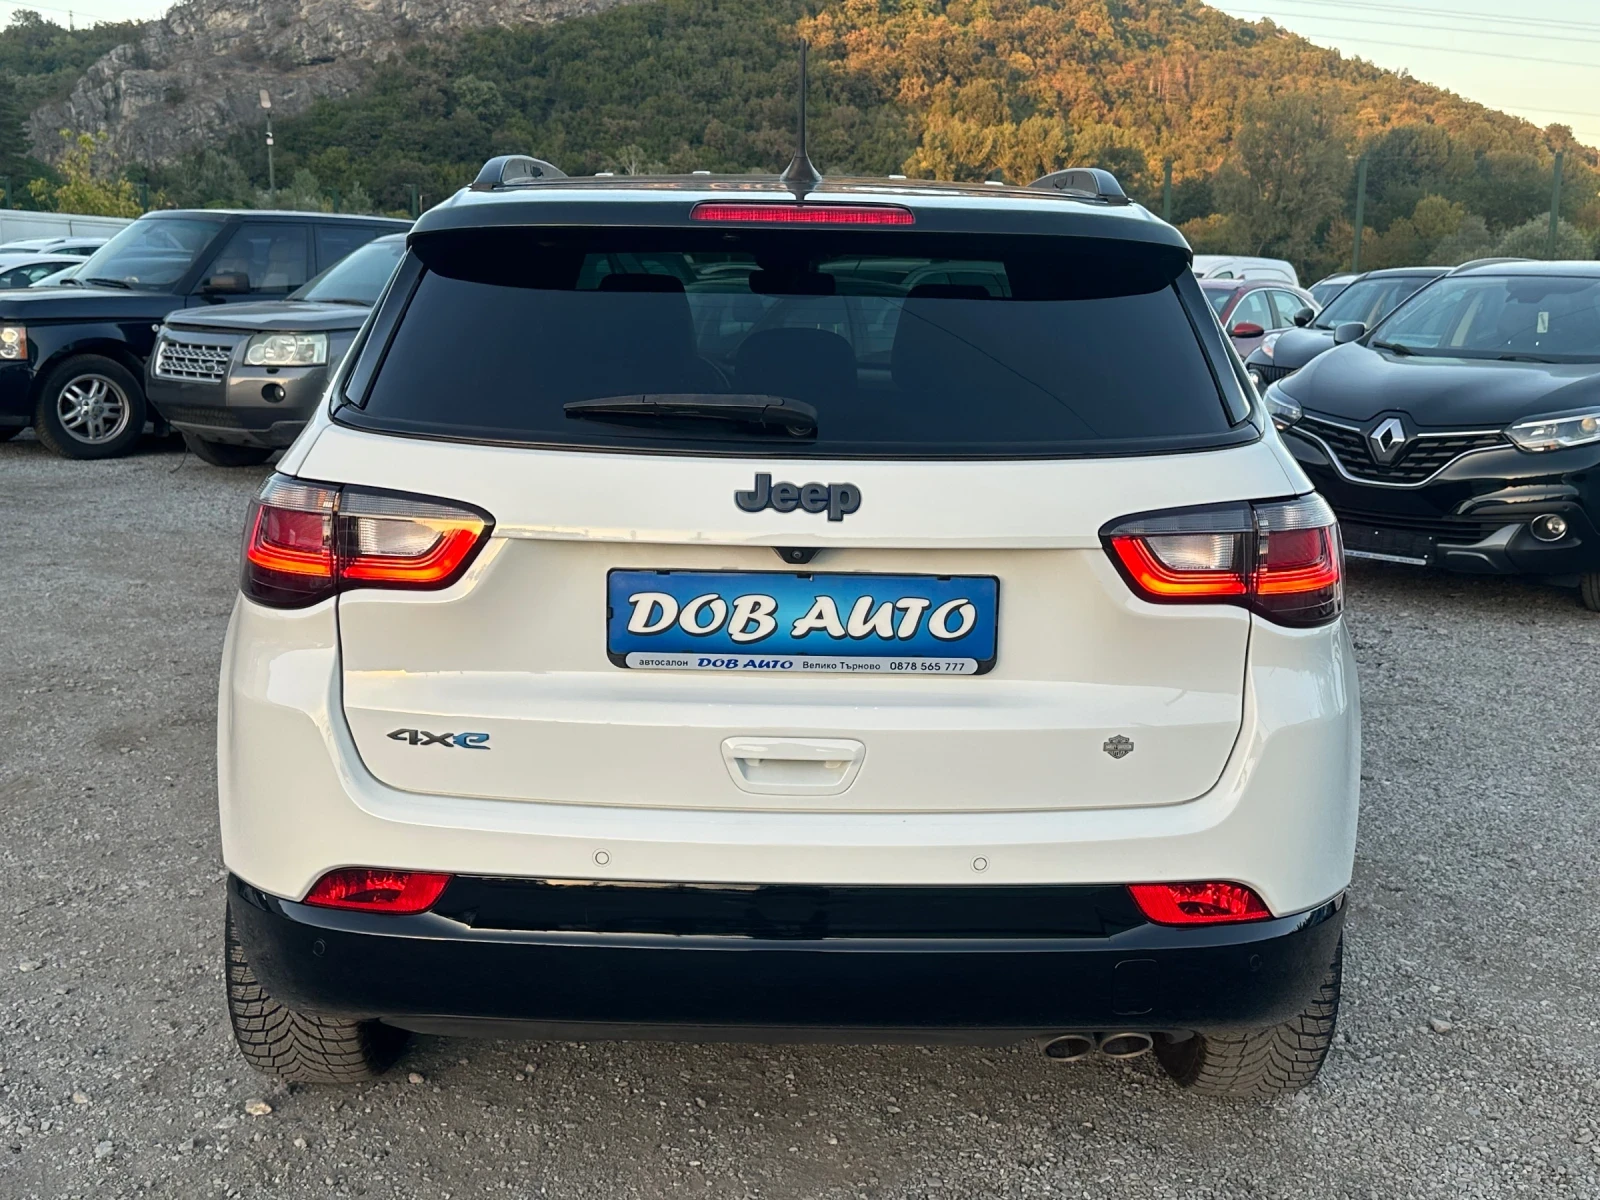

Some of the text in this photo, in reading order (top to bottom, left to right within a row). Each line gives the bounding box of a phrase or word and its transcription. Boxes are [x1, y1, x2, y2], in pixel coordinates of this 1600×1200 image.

[734, 471, 861, 522] Jeep
[627, 592, 977, 645] DOB AUTO
[638, 657, 965, 672] автосалон DOB AUTO Велико Търново 0878 565 777
